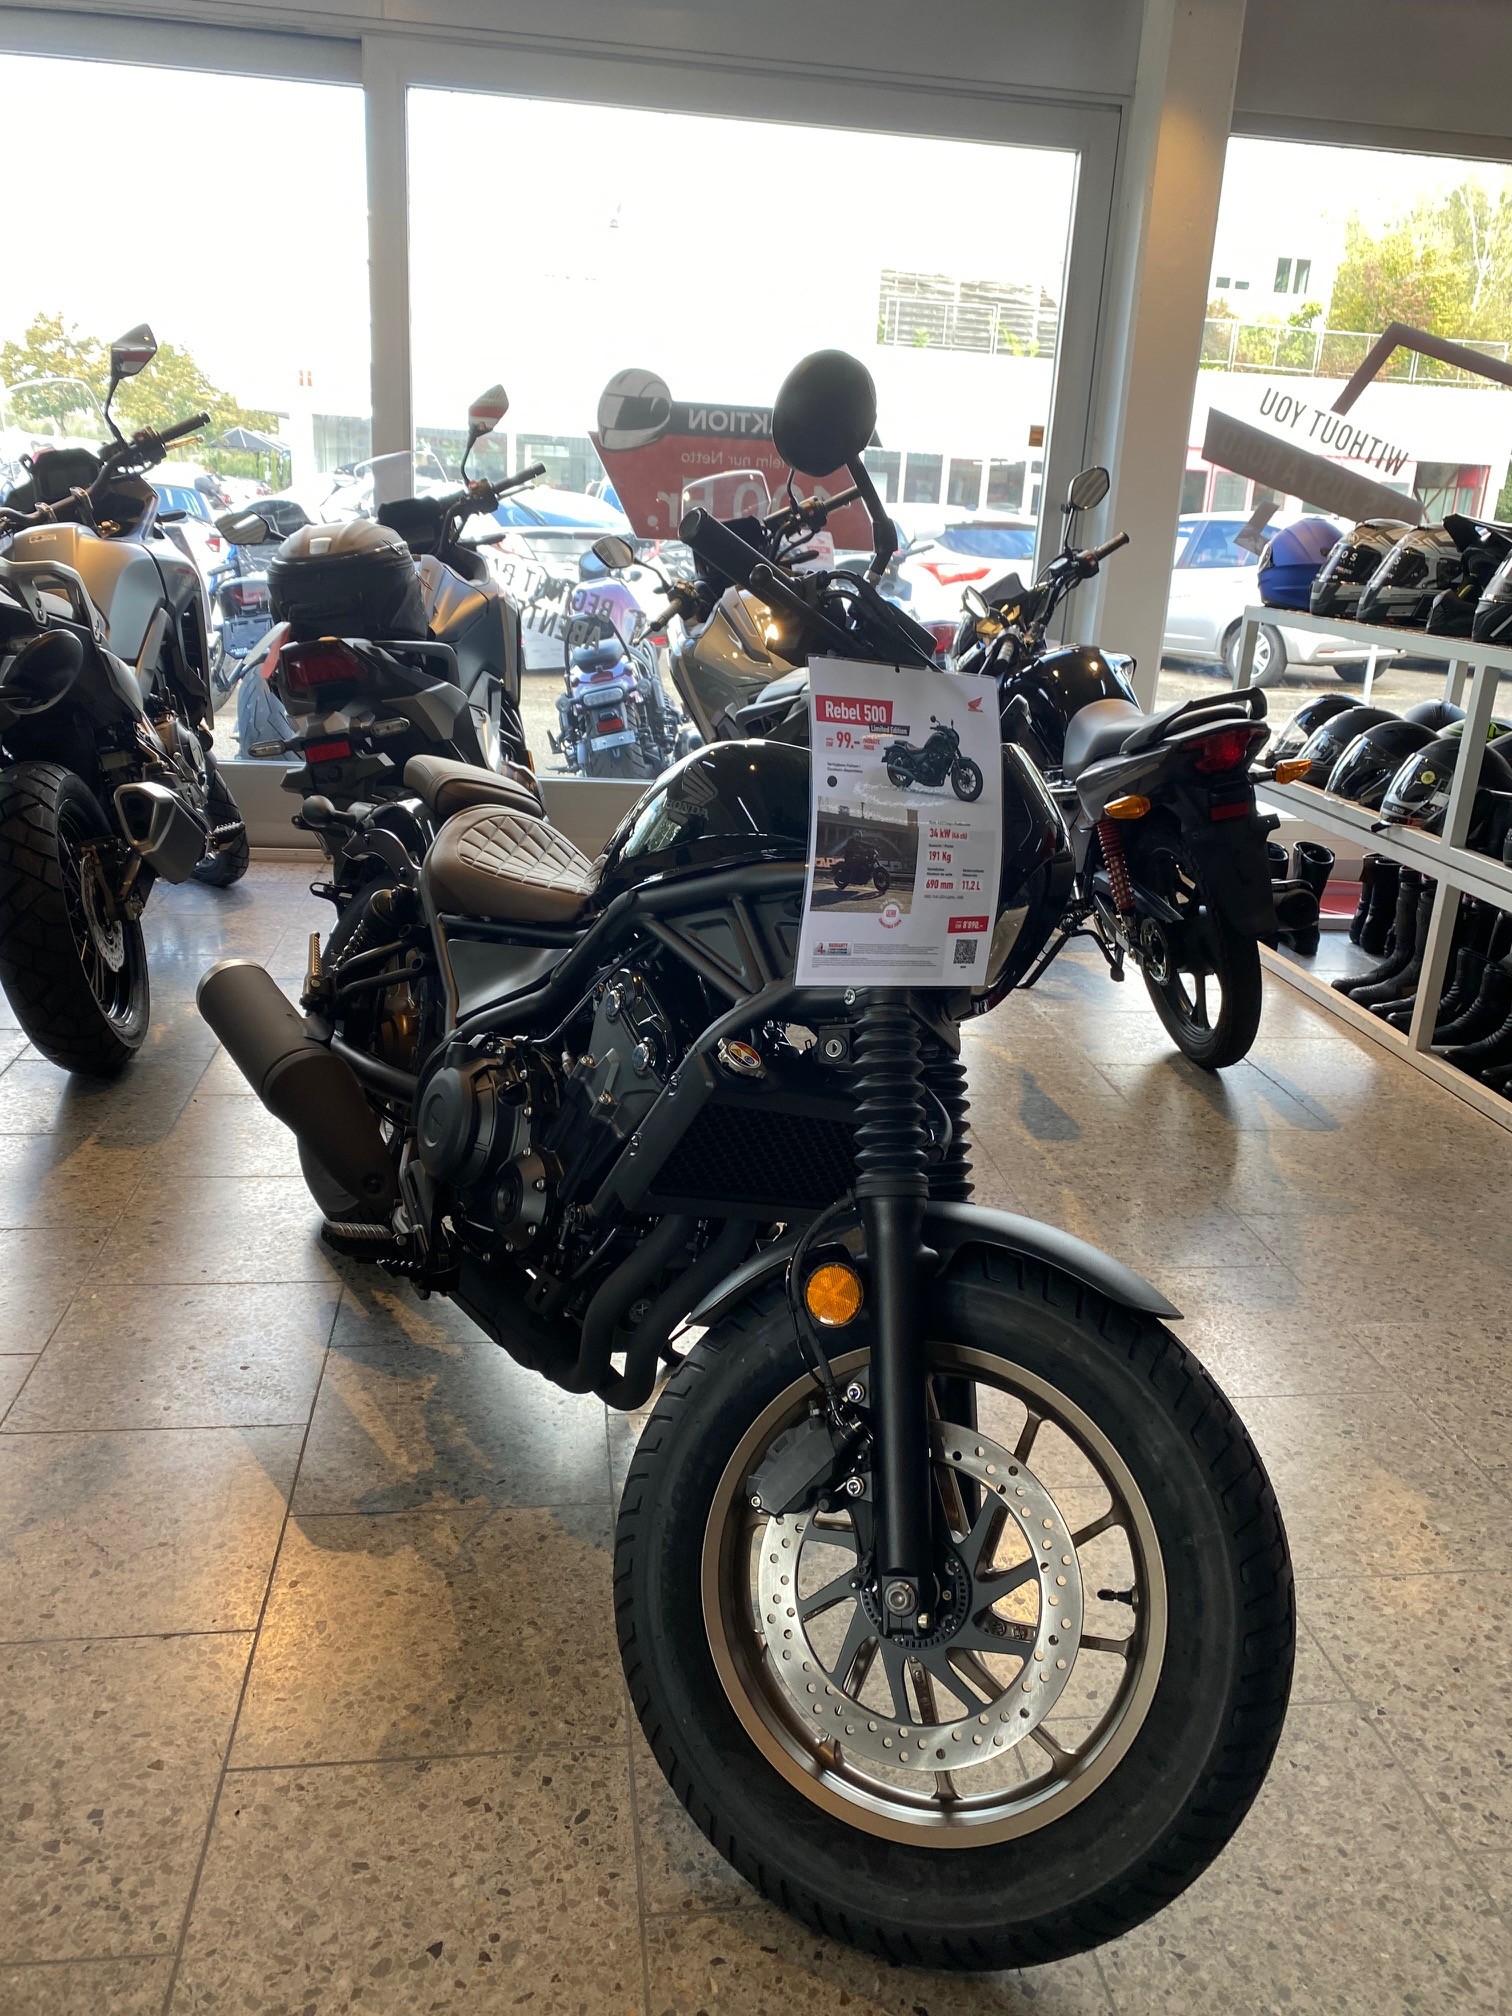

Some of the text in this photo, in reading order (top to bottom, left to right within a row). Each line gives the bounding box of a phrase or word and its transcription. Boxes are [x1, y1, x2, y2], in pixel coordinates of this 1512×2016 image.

[825, 700, 887, 723] Rebel 500
[890, 725, 908, 735] Edition
[665, 799, 709, 821] HONDA
[929, 828, 939, 838] 34
[940, 828, 951, 838] kW
[928, 850, 952, 864] 191 Kg
[925, 879, 954, 890] 690 mm
[962, 880, 981, 891] 11,2 L
